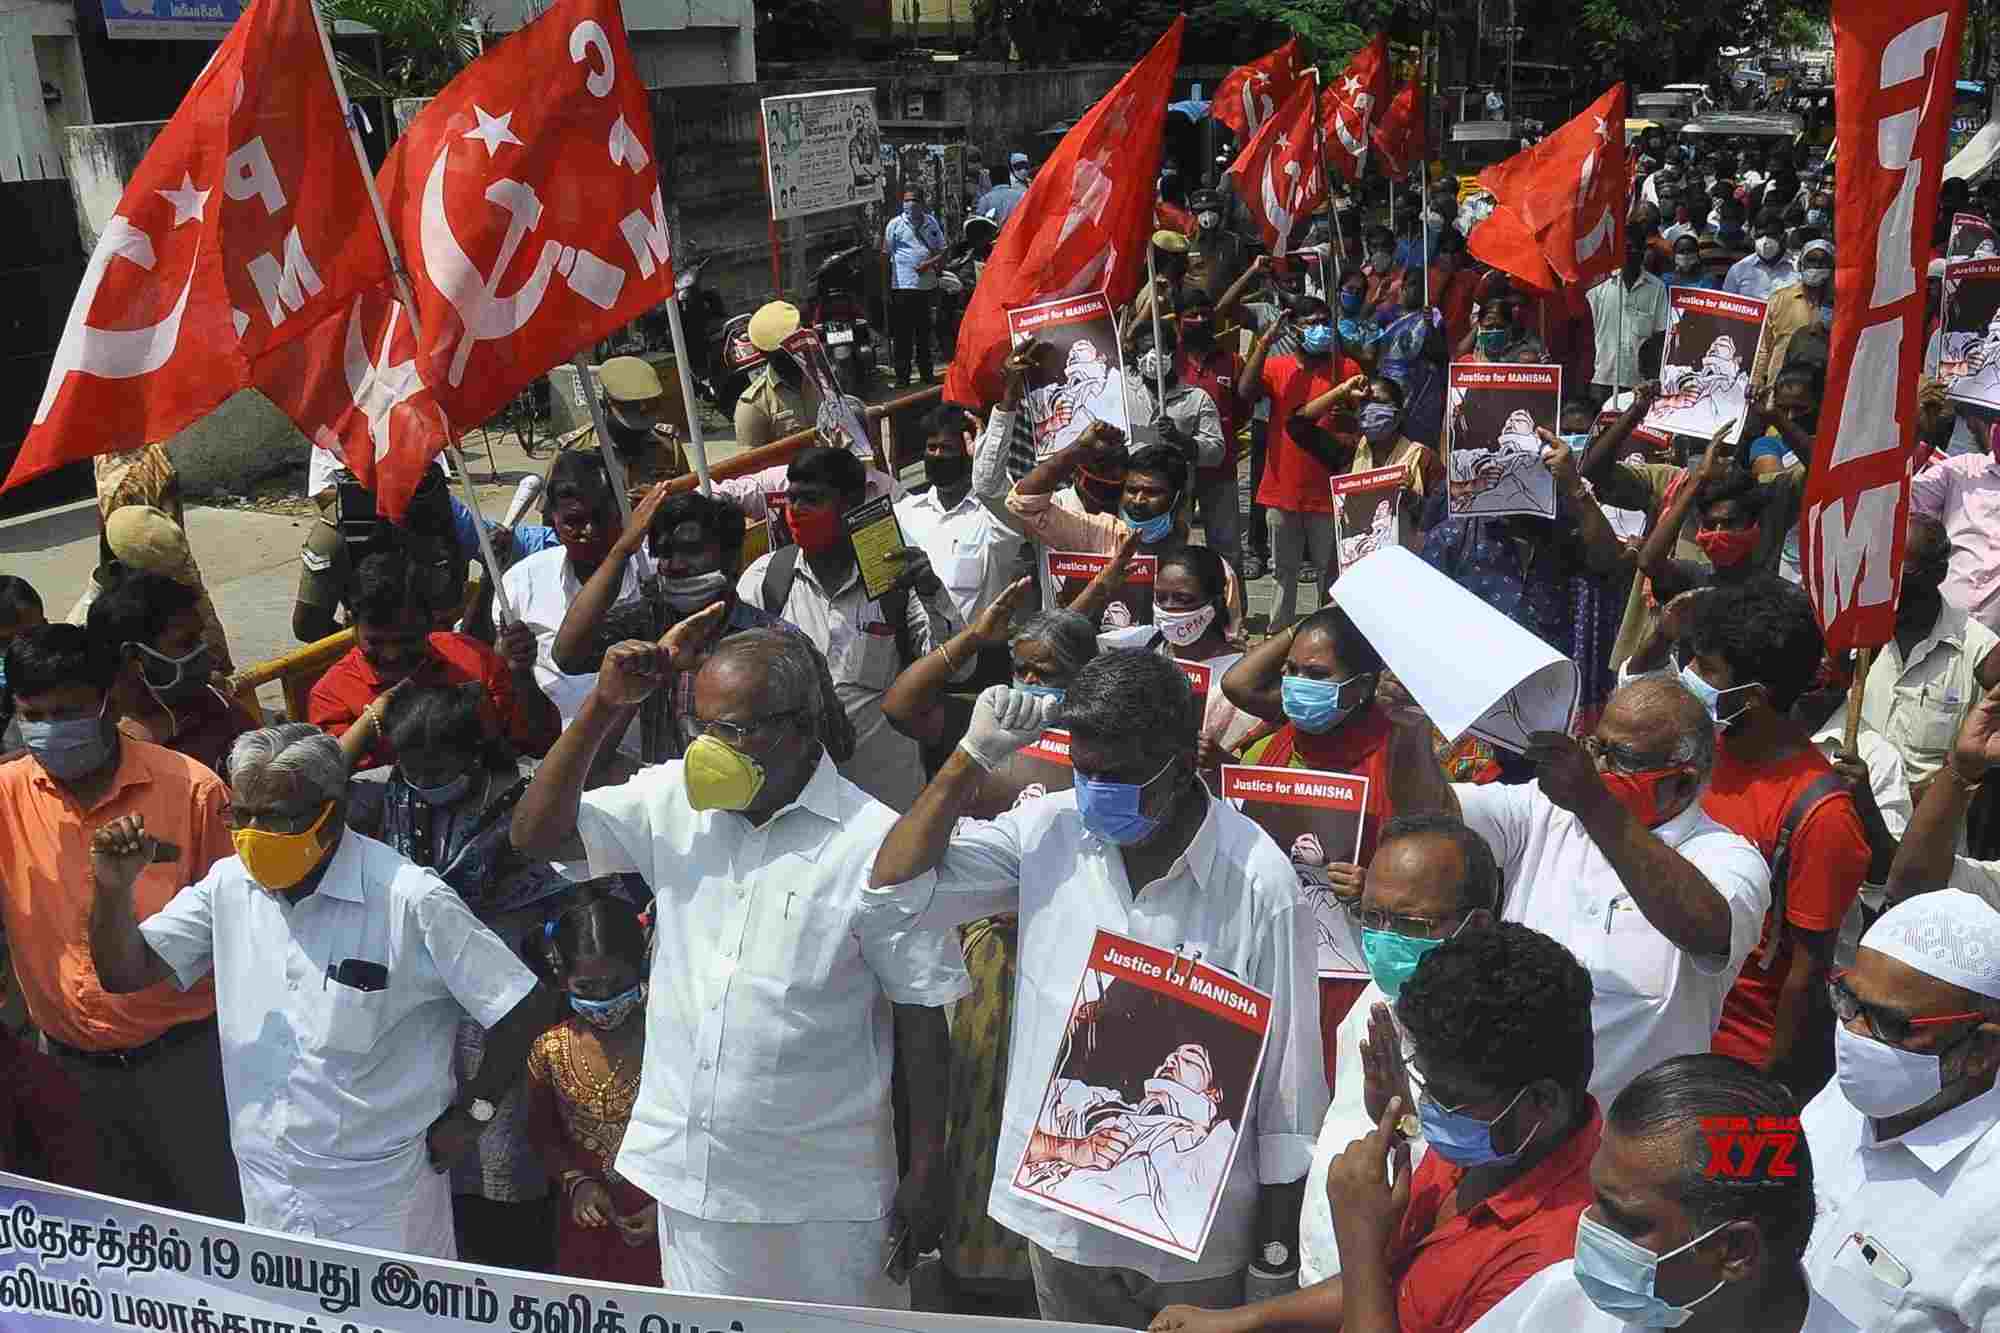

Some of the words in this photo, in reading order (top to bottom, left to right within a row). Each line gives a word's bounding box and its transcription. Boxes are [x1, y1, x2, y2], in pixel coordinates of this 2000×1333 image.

[1065, 300, 1104, 318] MANISHA
[1718, 300, 1760, 316] MANISHA
[1457, 372, 1491, 383] Justice
[1493, 372, 1506, 383] for
[1507, 372, 1552, 384] MANISHA
[1056, 559, 1088, 572] Justice
[1088, 563, 1103, 573] for
[1041, 738, 1071, 756] MANIS
[1233, 777, 1273, 793] Justice
[1275, 781, 1292, 794] for
[1294, 782, 1353, 801] MANISHA
[1103, 947, 1162, 978] Justice
[1165, 966, 1186, 987] for
[1189, 975, 1258, 1018] MANISHA
[200, 1235, 241, 1280] 19
[250, 1249, 361, 1314] வயது
[370, 1261, 499, 1324] இளம்
